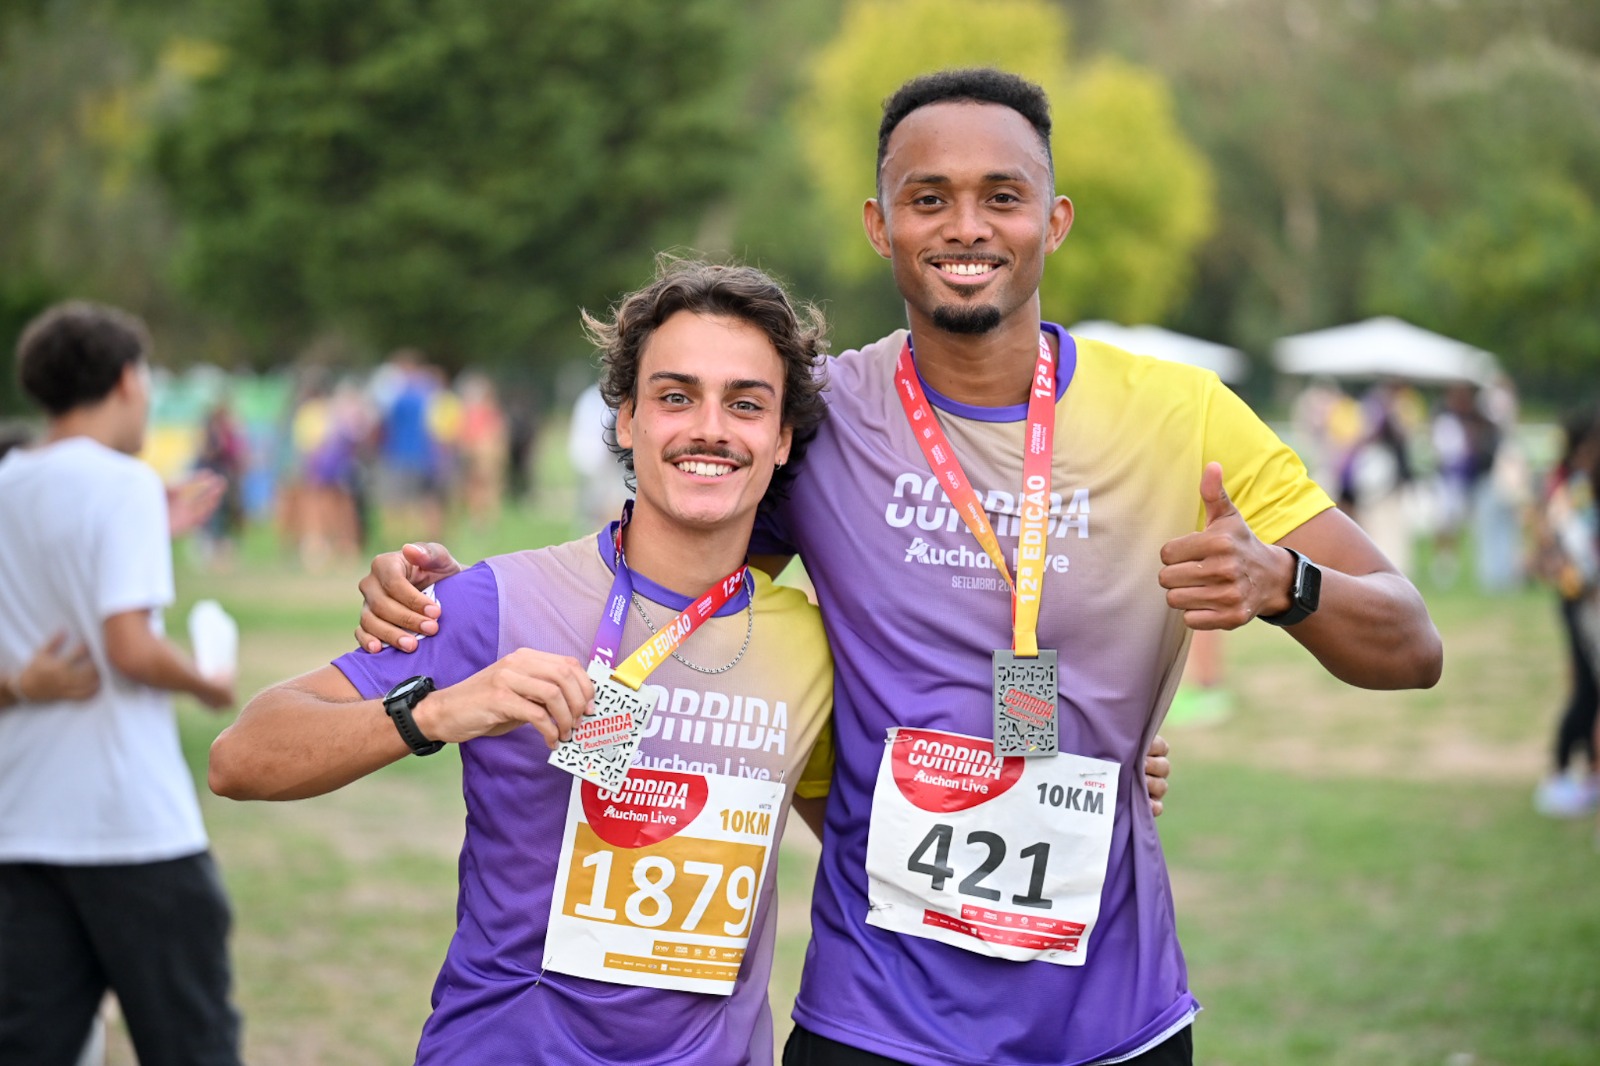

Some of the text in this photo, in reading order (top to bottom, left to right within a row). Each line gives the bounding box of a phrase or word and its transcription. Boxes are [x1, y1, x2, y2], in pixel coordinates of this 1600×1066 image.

[904, 537, 997, 569] Aucha
[951, 575, 997, 591] SETEMBRO
[653, 614, 692, 658] EDIÇÃO
[642, 684, 788, 756] ORRIDA
[1004, 688, 1055, 720] CORRIDA
[584, 733, 629, 750] Auchan Live
[907, 739, 1004, 780] CORRIDA
[913, 769, 989, 795] Auchan Live
[1037, 782, 1104, 815] 10KM
[603, 805, 677, 826] Auchan Live
[719, 808, 771, 836] 10KM
[907, 823, 1053, 910] 421
[574, 850, 756, 937] 1879
